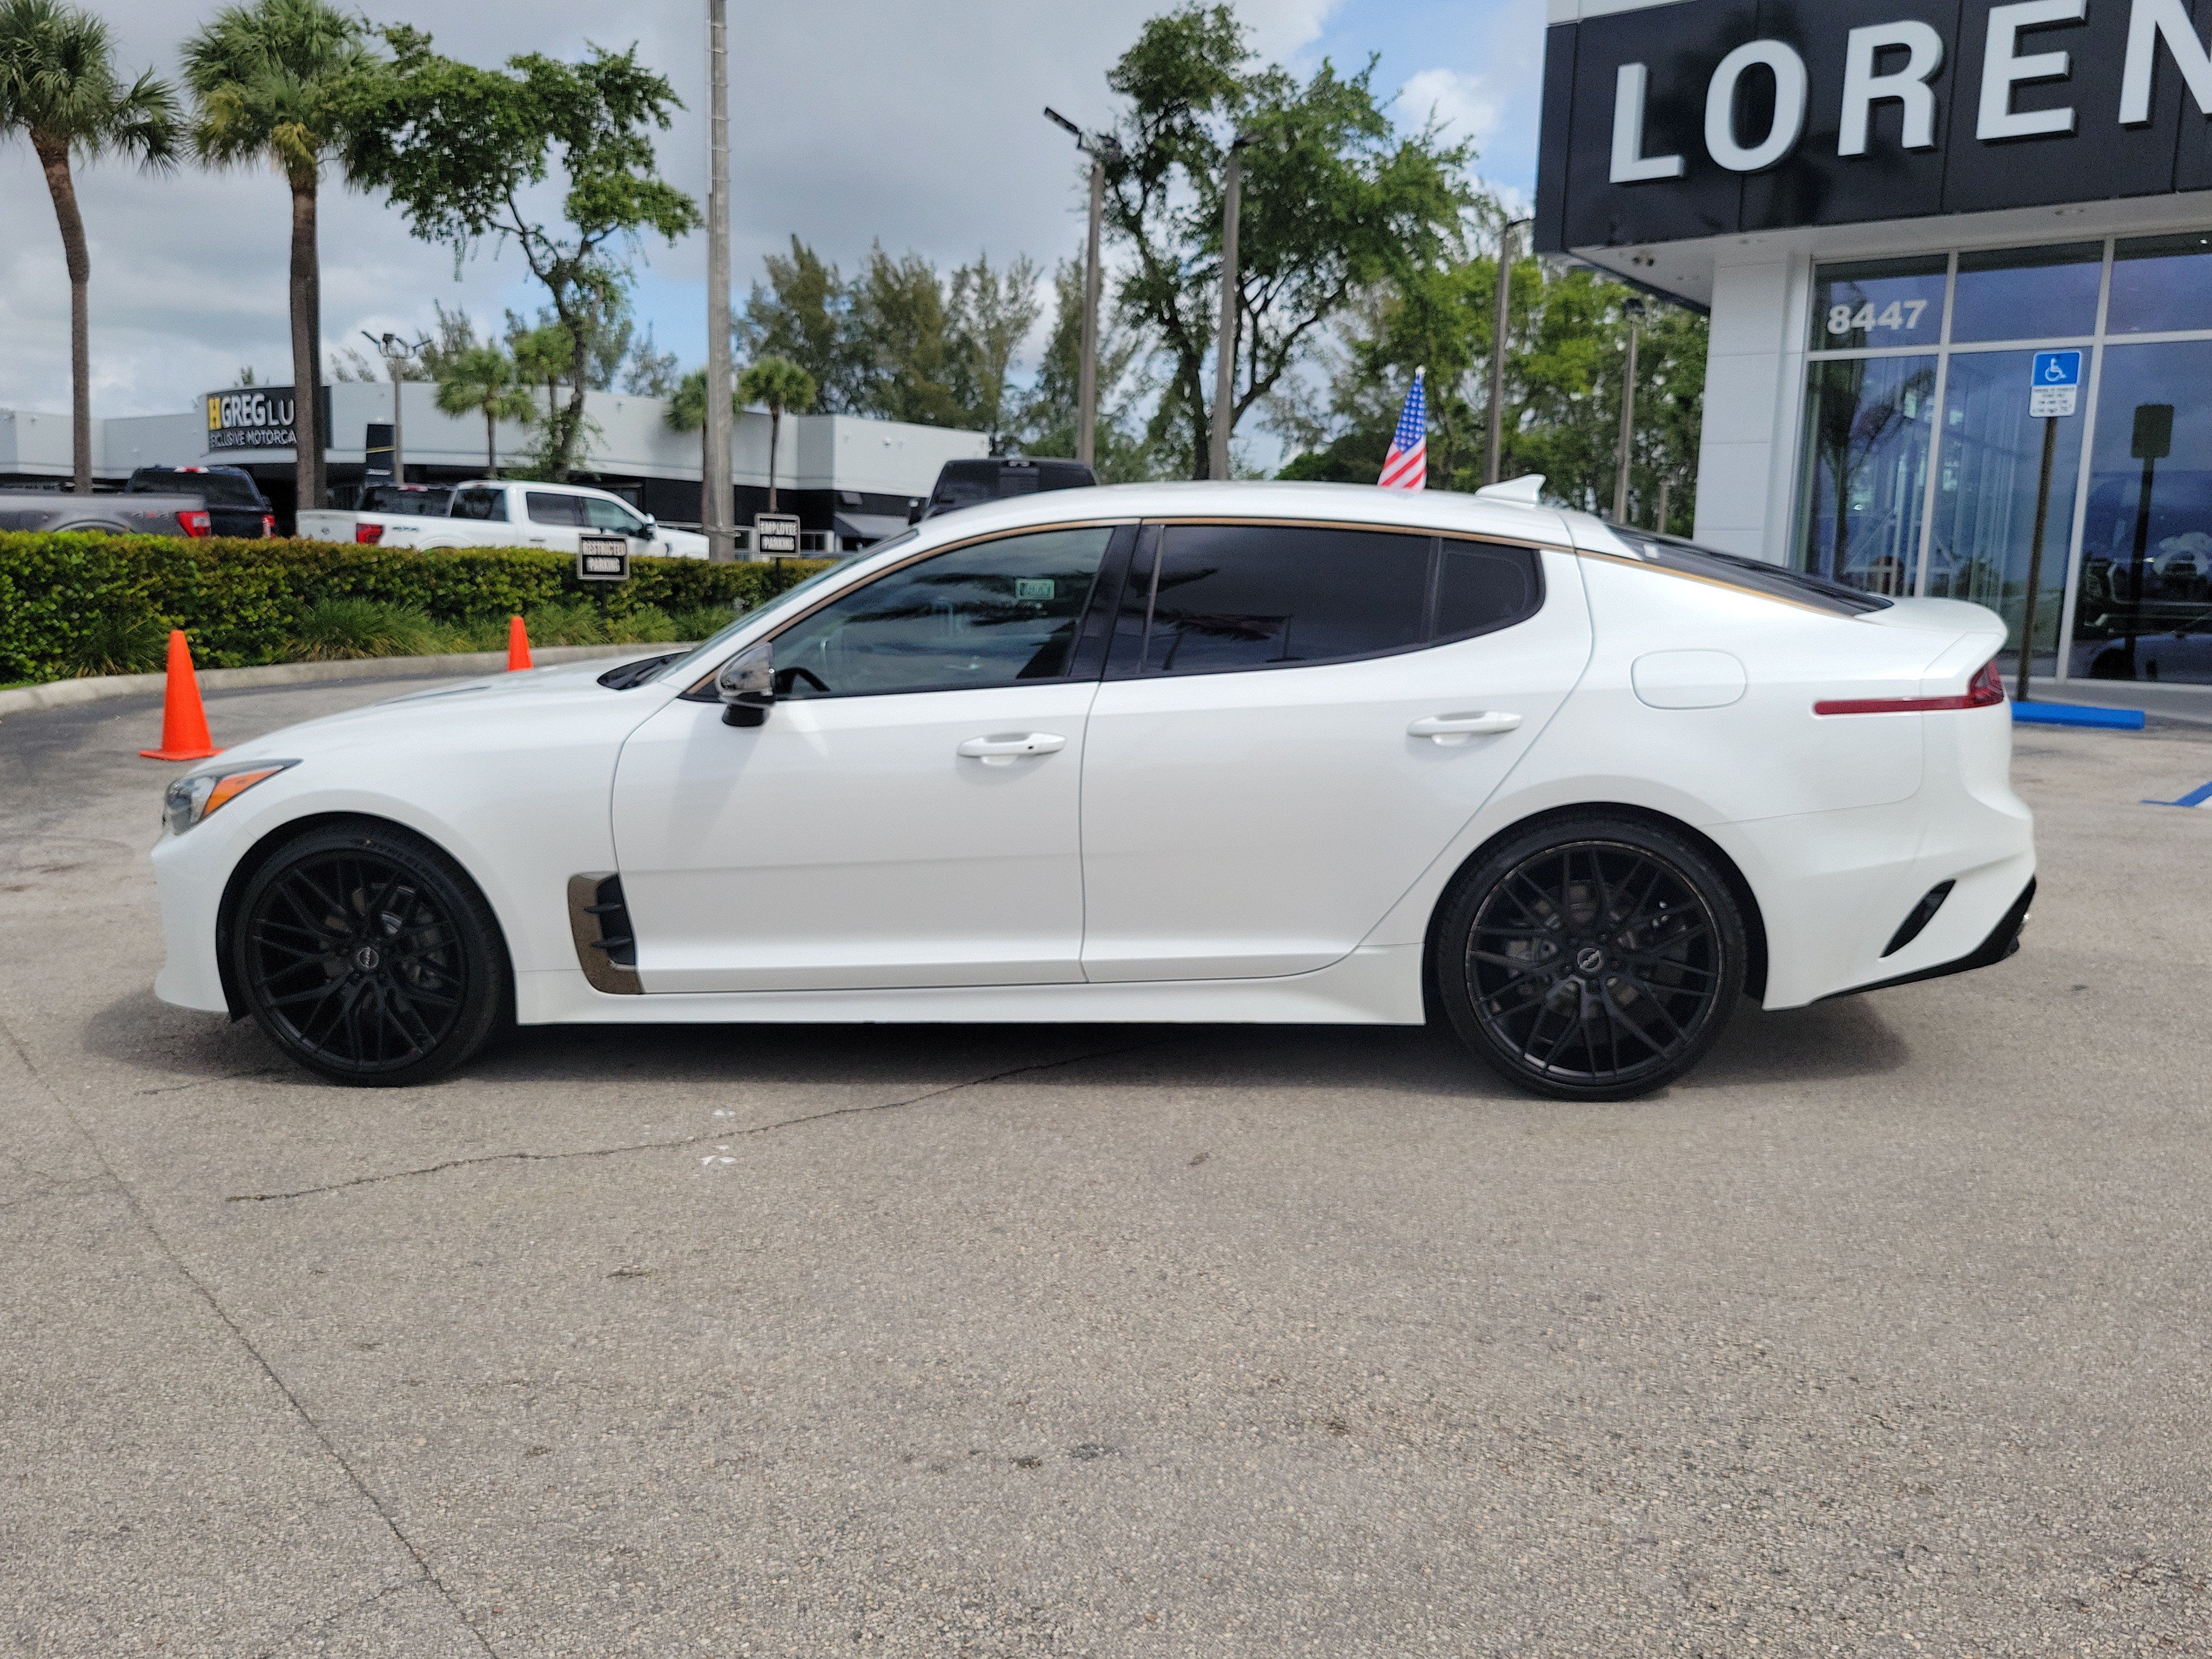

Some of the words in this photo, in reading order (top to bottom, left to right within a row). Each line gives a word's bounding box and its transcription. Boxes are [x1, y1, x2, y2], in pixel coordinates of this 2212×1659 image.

[1610, 0, 2211, 184] LOREN
[1827, 300, 1927, 335] 8447
[760, 520, 797, 536] EMPLOYEE
[582, 539, 626, 556] RESTRICTED
[761, 535, 795, 551] PARKING
[586, 556, 620, 572] PARKING
